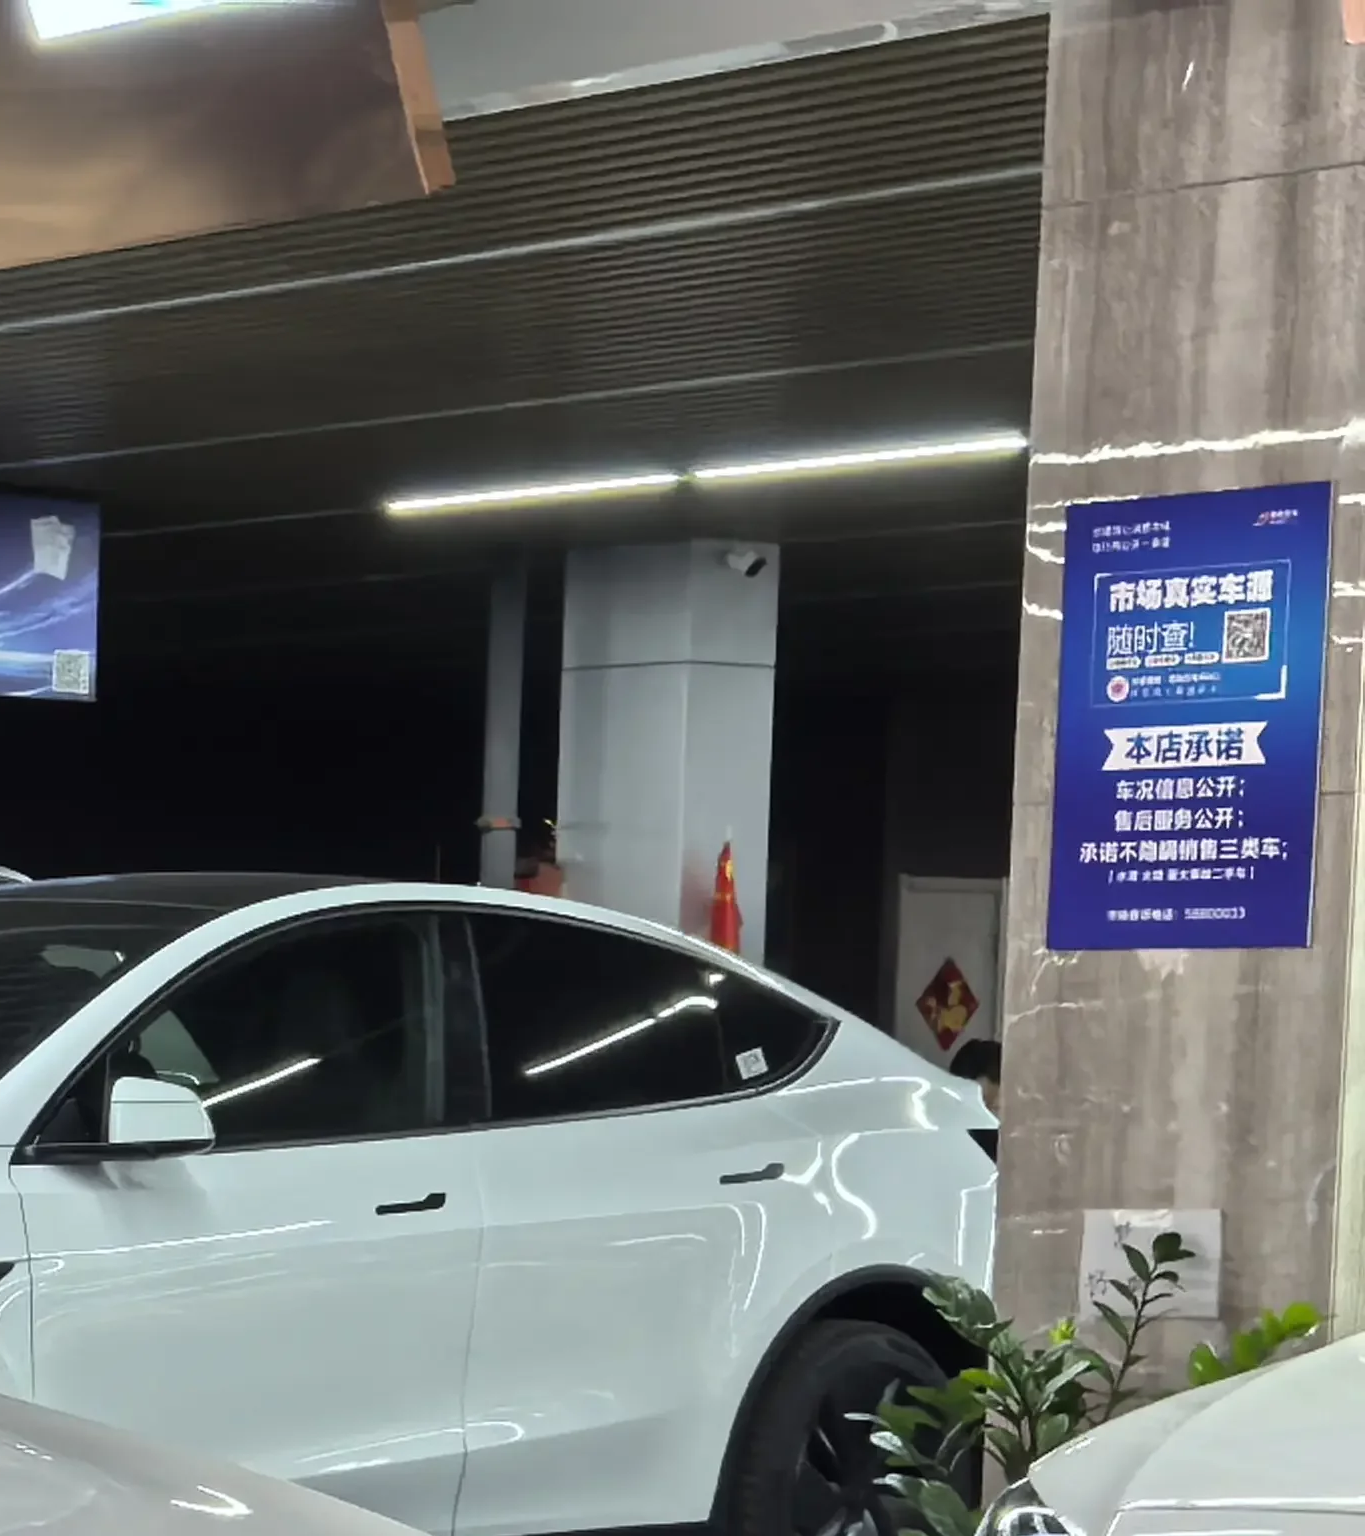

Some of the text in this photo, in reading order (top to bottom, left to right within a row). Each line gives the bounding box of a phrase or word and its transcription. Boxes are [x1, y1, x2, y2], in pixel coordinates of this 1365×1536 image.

[1109, 569, 1274, 612] 市场真实车源
[1125, 727, 1245, 765] 本店承诺
